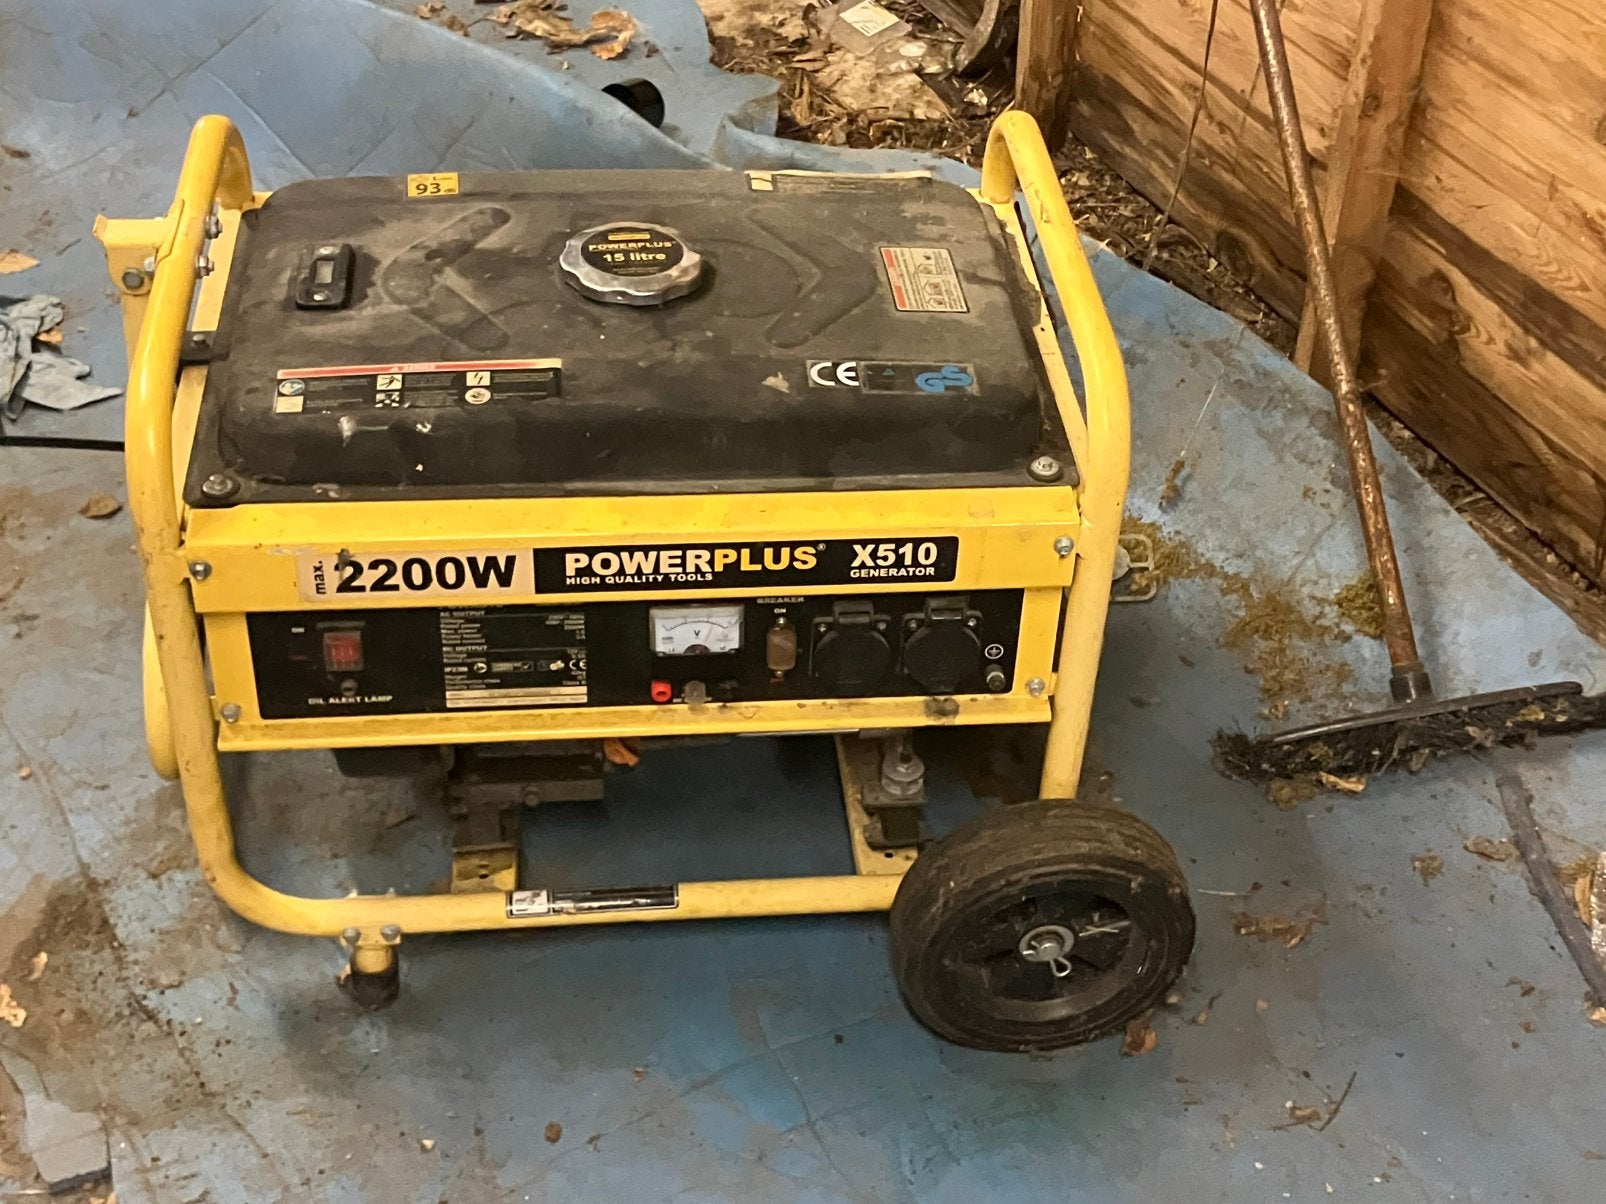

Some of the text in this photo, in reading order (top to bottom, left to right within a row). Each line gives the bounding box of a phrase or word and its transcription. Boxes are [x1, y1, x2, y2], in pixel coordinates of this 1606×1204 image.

[415, 183, 441, 195] 93
[603, 252, 667, 262] 15 litre
[810, 361, 860, 387] CE
[851, 542, 938, 567] X510
[312, 560, 326, 595] max.
[334, 554, 517, 594] 2200W
[566, 573, 713, 585] HIGH QUALITY TOOLS
[850, 567, 935, 578] GENERATOR
